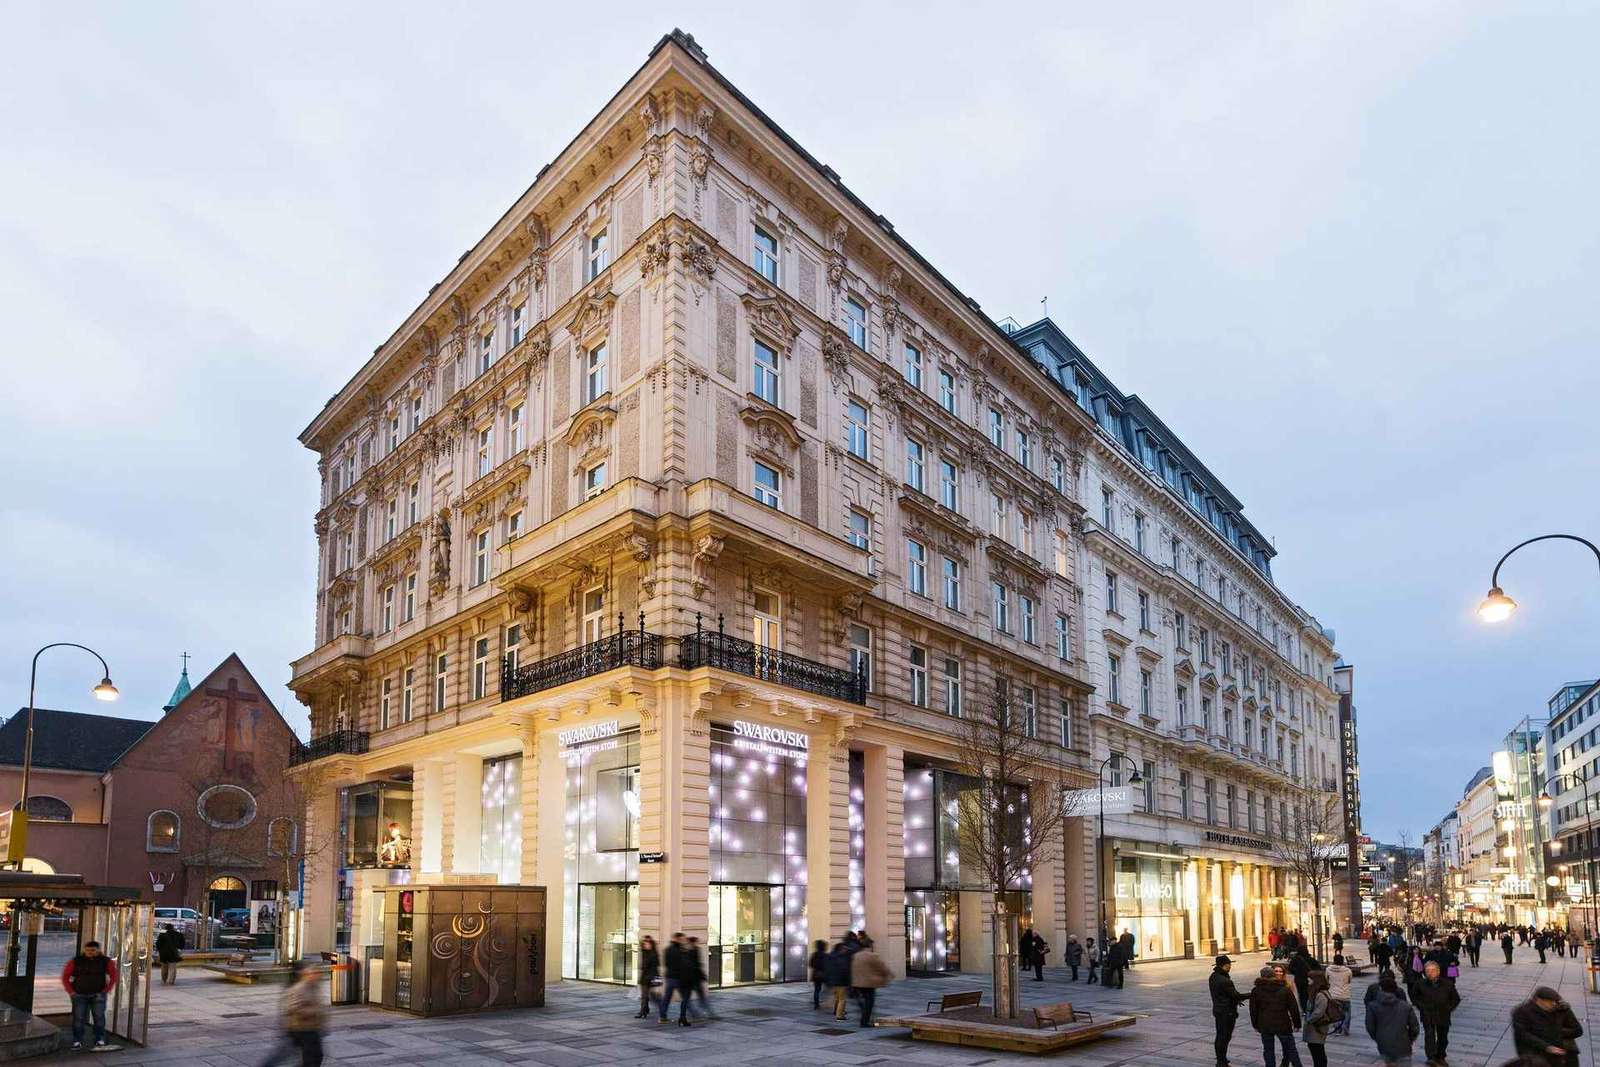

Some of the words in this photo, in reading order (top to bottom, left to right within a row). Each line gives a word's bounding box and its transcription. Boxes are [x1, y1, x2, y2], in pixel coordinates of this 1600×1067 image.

[558, 719, 618, 746] SWAROVSKI
[733, 720, 808, 748] SWAROVSKI
[1344, 722, 1353, 764] HOTEL
[1346, 775, 1355, 828] EUROPA
